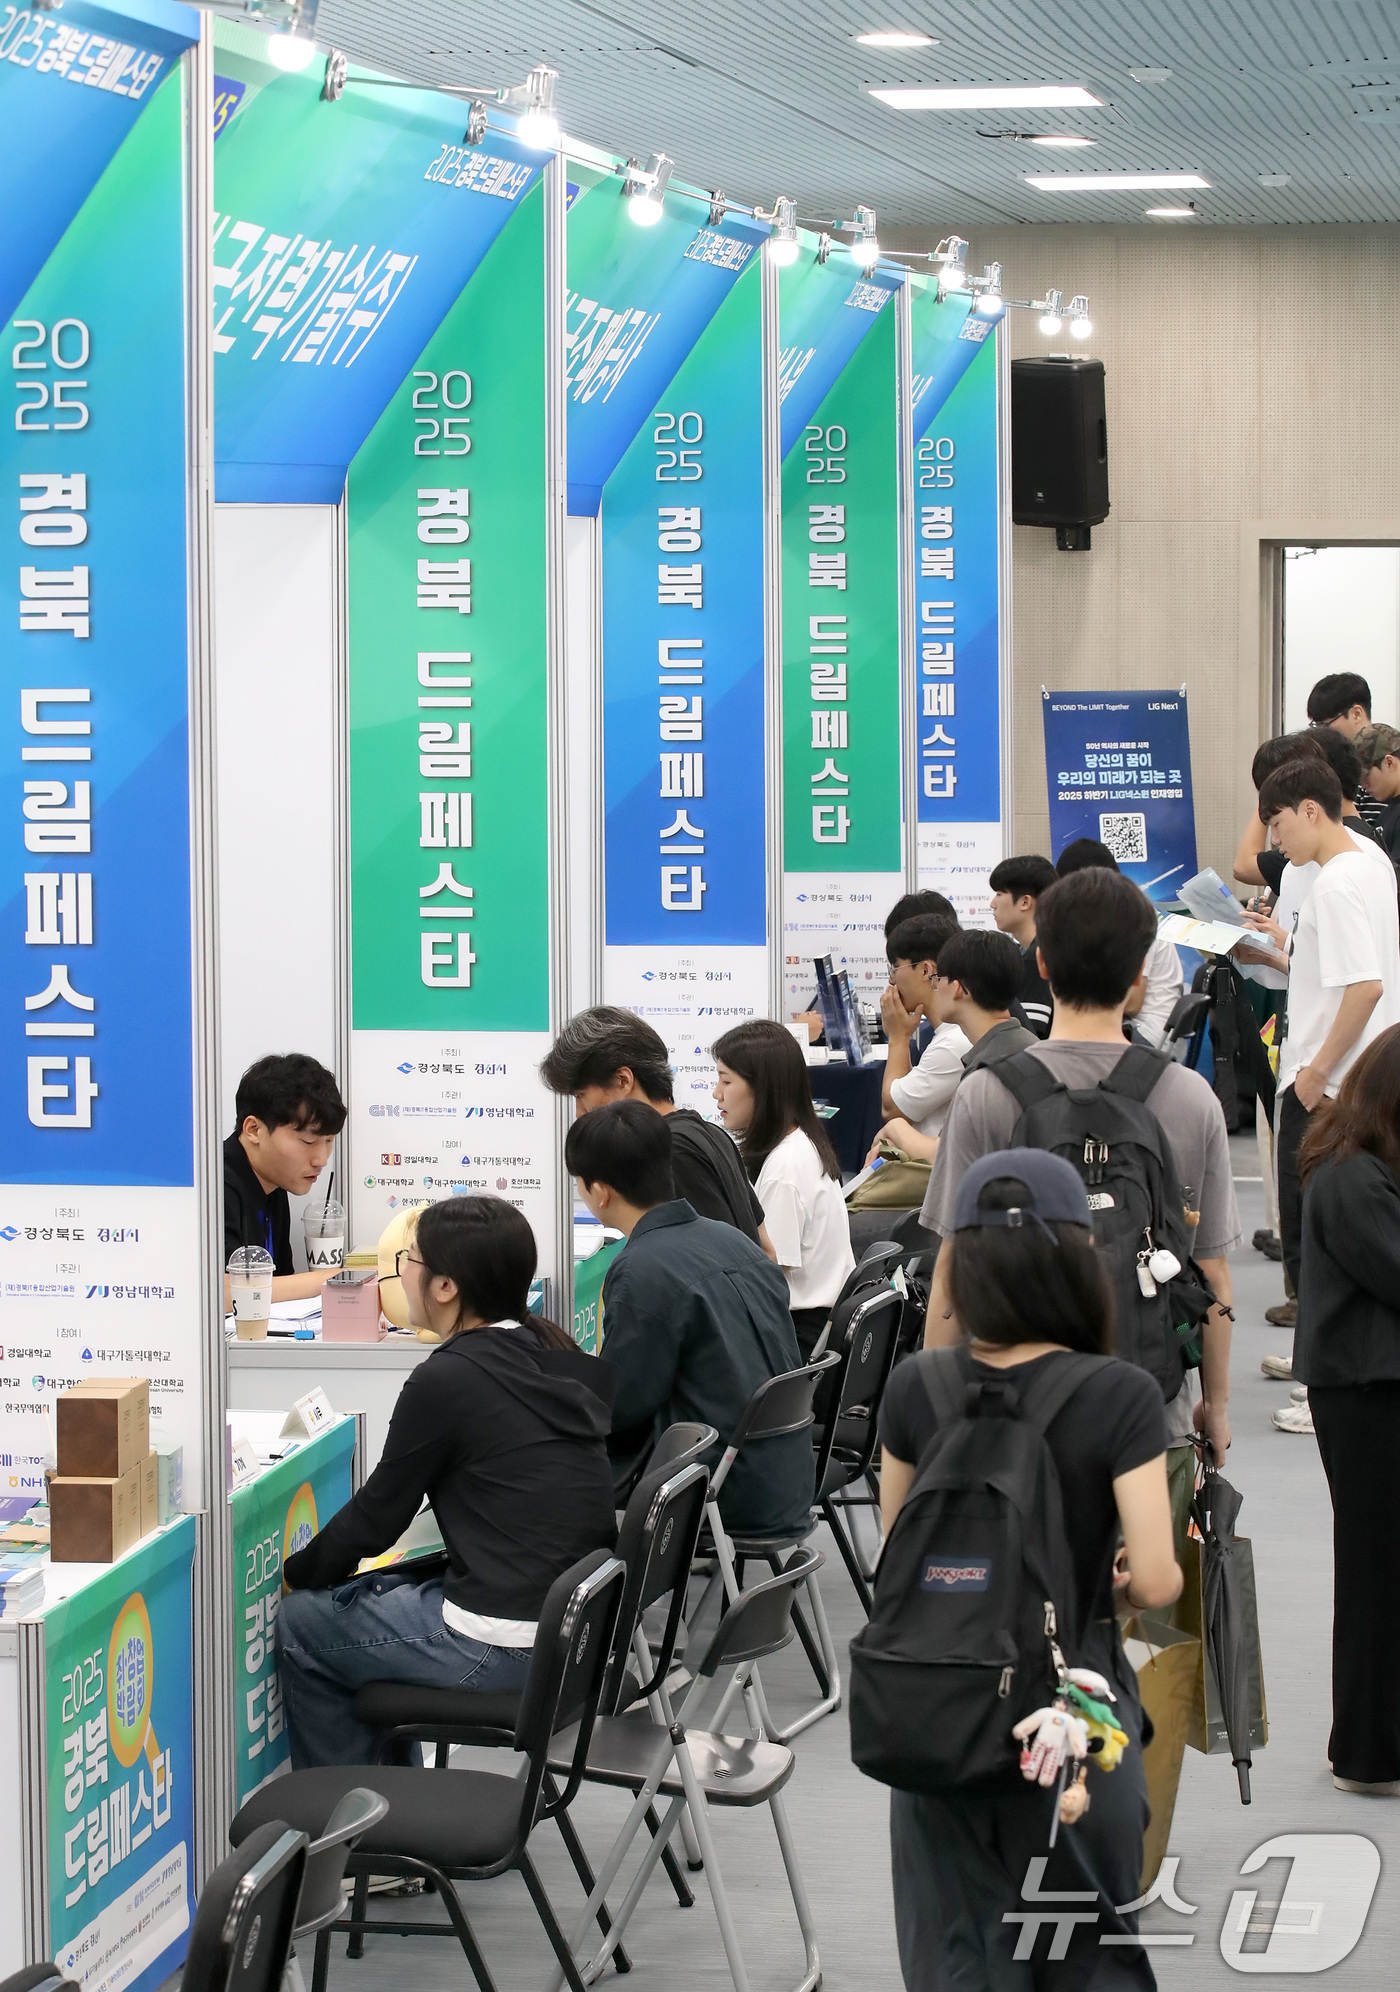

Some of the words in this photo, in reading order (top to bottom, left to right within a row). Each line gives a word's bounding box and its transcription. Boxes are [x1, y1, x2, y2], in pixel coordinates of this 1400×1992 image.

[12, 319, 89, 369] 20
[412, 371, 472, 409] 20
[15, 381, 89, 430] 25
[655, 412, 703, 443] 20
[414, 418, 471, 456] 25
[805, 426, 847, 452] 20
[918, 438, 954, 461] 20
[655, 451, 703, 481] 25
[806, 458, 847, 483] 25
[919, 466, 954, 488] 25
[416, 488, 471, 614] 경북
[808, 505, 847, 590] 경북
[921, 506, 954, 580] 경북
[20, 473, 90, 639] 경북
[658, 506, 703, 608] 경북
[922, 602, 957, 799] 드림페스타
[1105, 703, 1129, 711] Together
[1161, 702, 1178, 710] Nex1
[809, 616, 850, 844] 드림페스타
[1101, 742, 1119, 750] 역사의
[1138, 741, 1149, 749] 시작
[1085, 753, 1123, 768] 당신의
[1126, 752, 1152, 767] 꿈이
[658, 640, 707, 911] 드림페스타
[1057, 771, 1096, 786] 우리의
[1099, 770, 1138, 785] 미래가
[1140, 769, 1166, 785] 되는
[1169, 769, 1182, 784] 곳
[1058, 791, 1082, 800] 2025
[1084, 791, 1109, 800] 하반기
[1109, 790, 1149, 800] LIG넥스원
[1150, 789, 1183, 799] 인재영입
[417, 652, 476, 988] 드림페스타
[810, 894, 843, 902] 경상북도
[21, 689, 100, 1129] 드림페스타
[658, 972, 698, 981] 경상북도
[714, 1007, 754, 1016] 영남대학교
[444, 1049, 457, 1057] 주최
[418, 1063, 465, 1074] 경상북도
[474, 1063, 507, 1075] 경산시
[445, 1091, 458, 1099] 주관
[485, 1107, 535, 1118] 영남대학교
[403, 1156, 438, 1164] 경일대학교
[473, 1156, 531, 1166] 대구가톨릭대학교
[377, 1177, 414, 1187] 대구대학교
[510, 1178, 541, 1186] 호산대학교
[58, 1207, 76, 1218] 주최
[24, 1227, 85, 1242] 경상북도
[97, 1228, 139, 1243] 경산시
[59, 1263, 77, 1274] 주관
[112, 1285, 175, 1299] 영남대학교
[60, 1327, 78, 1339] 참여
[7, 1348, 52, 1359] 경일대학교
[97, 1350, 172, 1362] 대구가톨릭대학교
[14, 1456, 46, 1466] 한국TO
[245, 1529, 280, 1594] 2025
[924, 1566, 988, 1585] JANSPORT
[62, 1648, 105, 1723] 2025
[64, 1707, 108, 1813] 경북
[65, 1748, 173, 1909] 드림페스타
